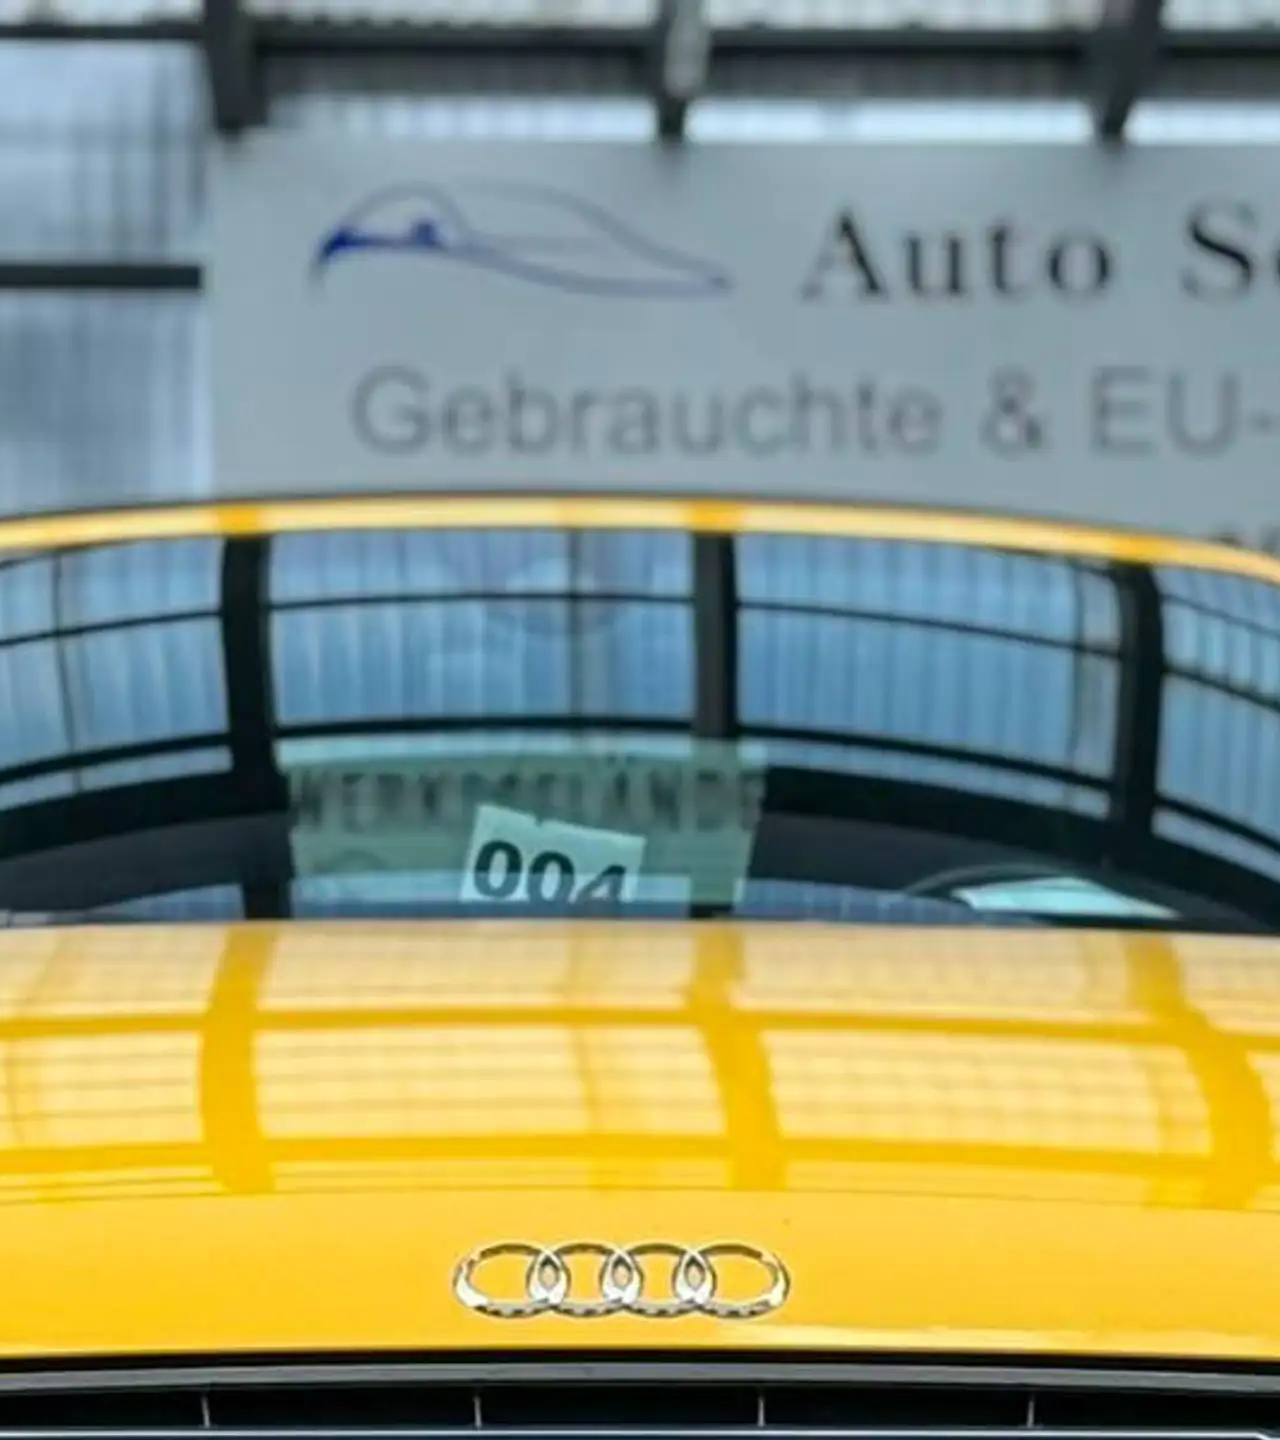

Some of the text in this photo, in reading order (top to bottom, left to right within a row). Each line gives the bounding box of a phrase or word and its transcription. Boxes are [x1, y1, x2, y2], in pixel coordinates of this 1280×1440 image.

[802, 203, 1114, 300] Auto
[350, 362, 944, 458] Gebrauchte
[980, 365, 1046, 458] &
